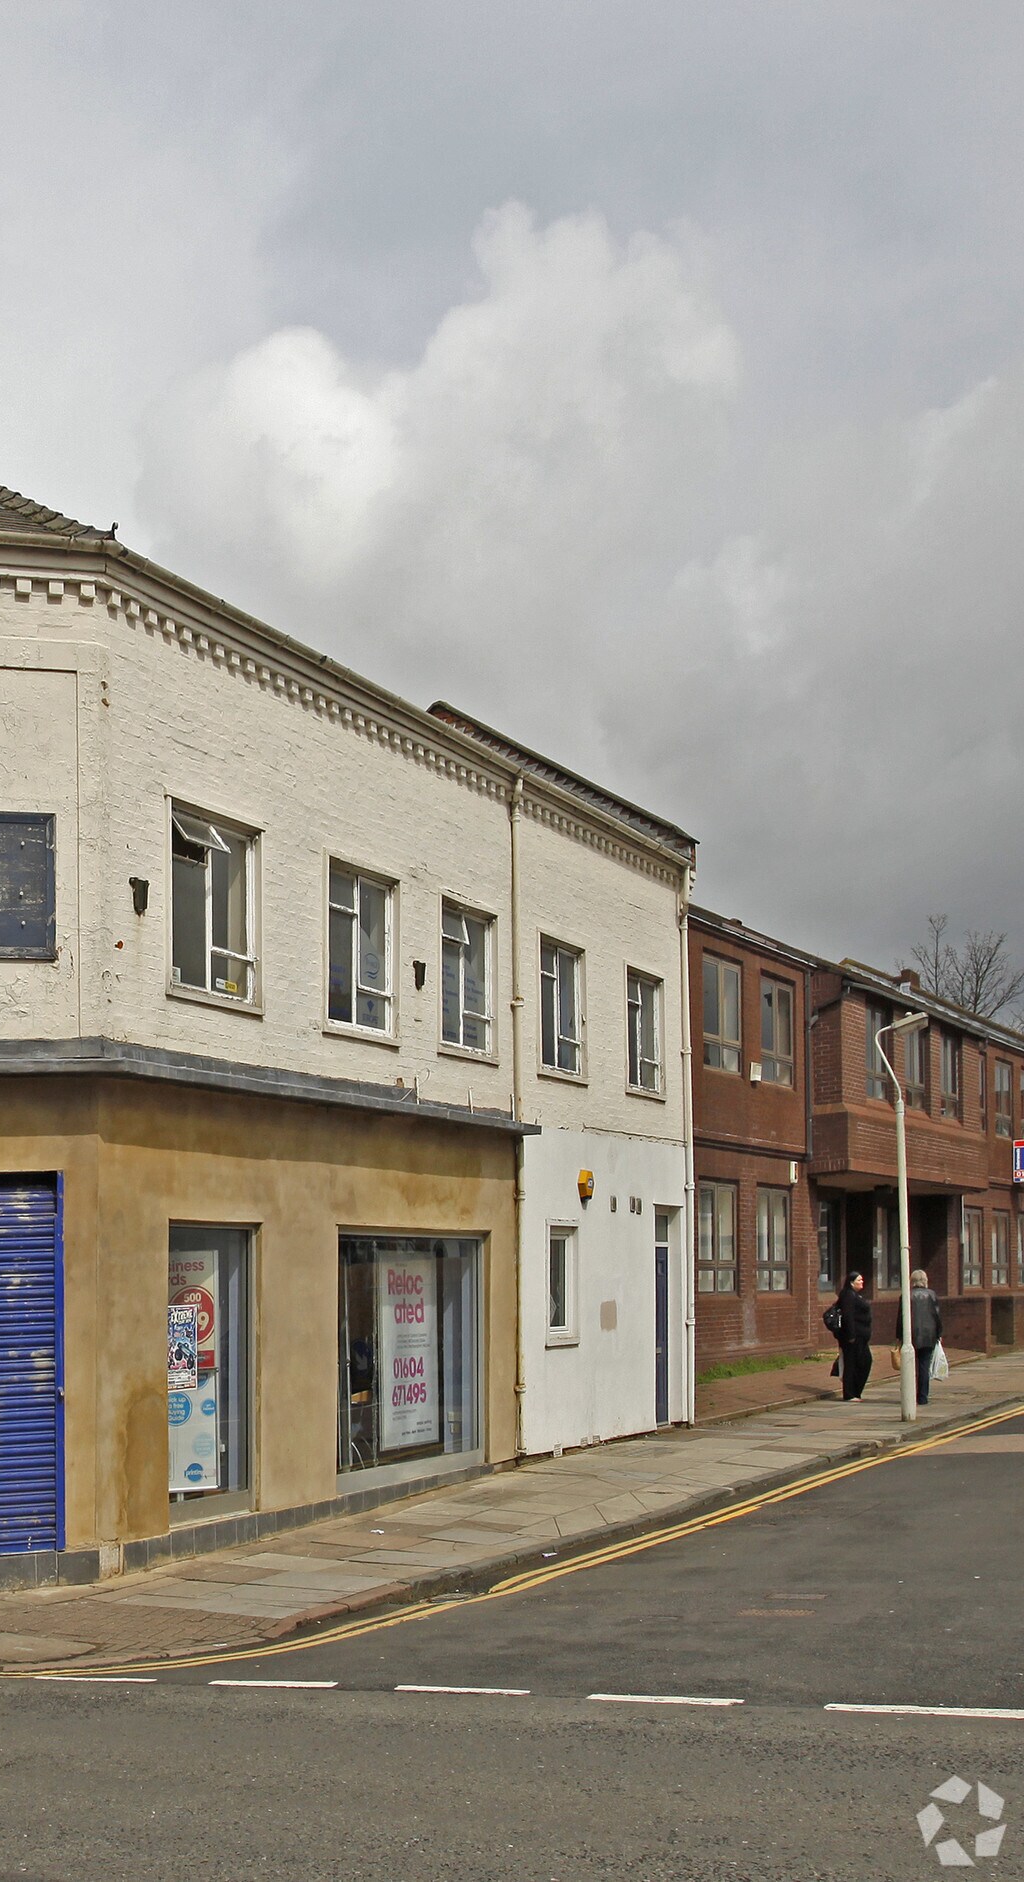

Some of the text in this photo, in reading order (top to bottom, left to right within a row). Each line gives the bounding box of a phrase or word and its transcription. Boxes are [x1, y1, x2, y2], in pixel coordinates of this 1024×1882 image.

[388, 1269, 423, 1295] Reloc
[184, 1292, 201, 1302] 500
[394, 1298, 424, 1324] ated
[393, 1356, 424, 1379] 01604
[392, 1382, 427, 1406] 671495
